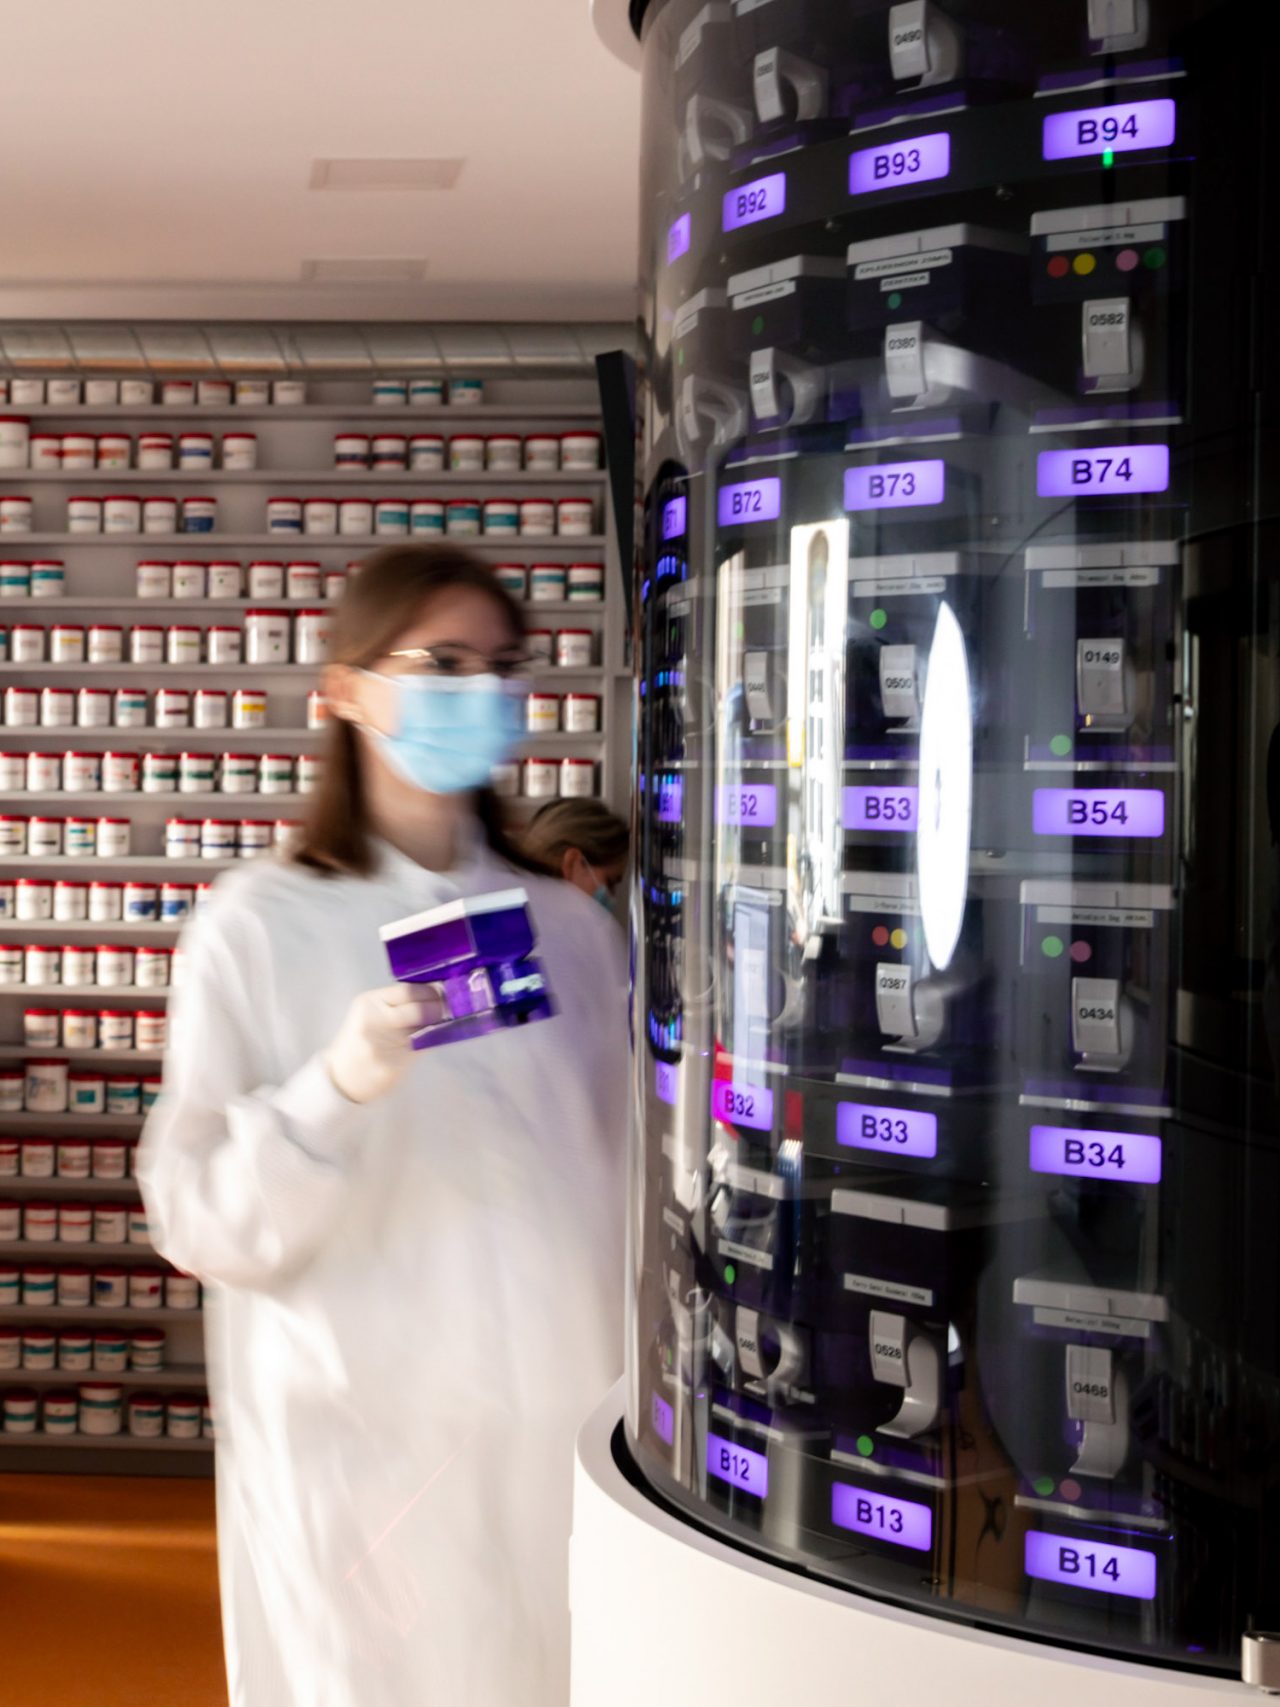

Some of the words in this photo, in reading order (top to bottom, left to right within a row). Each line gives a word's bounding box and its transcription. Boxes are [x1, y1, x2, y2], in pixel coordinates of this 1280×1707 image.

[1078, 115, 1138, 144] B94
[873, 148, 921, 180] B93
[736, 189, 766, 217] B92
[1090, 313, 1124, 326] 0582
[1073, 458, 1132, 484] B74
[870, 473, 915, 498] B73
[733, 490, 761, 514] B72
[1085, 651, 1120, 663] 0149
[729, 793, 758, 818] B52
[866, 796, 910, 820] B53
[1069, 800, 1127, 824] B54
[880, 977, 906, 989] 0387
[1079, 1008, 1114, 1020] 0434
[725, 1090, 754, 1117] B32
[861, 1114, 909, 1144] B33
[1065, 1140, 1125, 1168] B34
[1073, 1382, 1108, 1397] 0468
[720, 1447, 750, 1481] B12
[856, 1499, 903, 1534] B13
[1058, 1548, 1121, 1583] B14
